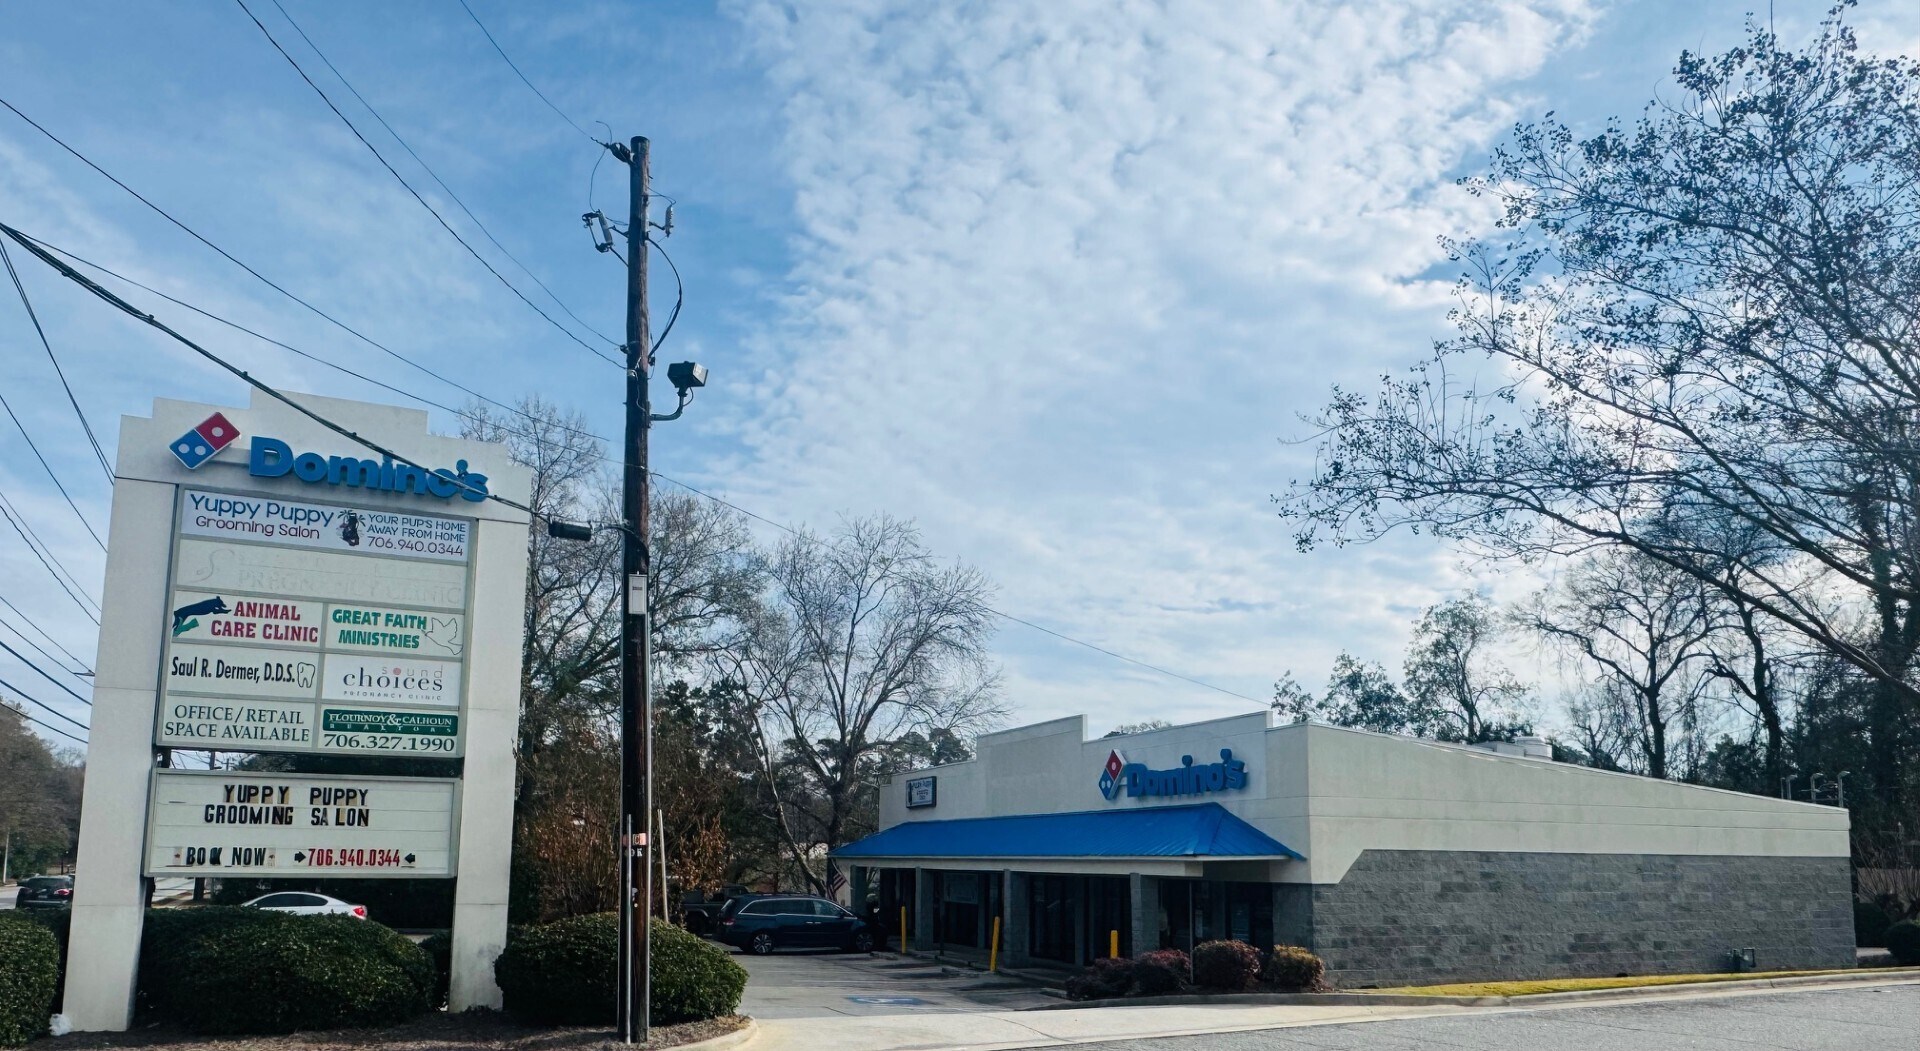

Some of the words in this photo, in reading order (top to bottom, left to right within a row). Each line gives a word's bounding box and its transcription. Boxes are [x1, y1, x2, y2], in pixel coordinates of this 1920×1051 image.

[249, 435, 490, 503] Domino's
[190, 493, 261, 518] Yuppy
[267, 501, 334, 527] Puppy
[196, 515, 275, 536] Grooming
[278, 523, 320, 539] Salon
[366, 524, 398, 536] AWAY
[402, 527, 432, 540] FROM
[435, 531, 465, 543] HOME
[368, 514, 399, 526] YOUR
[402, 517, 433, 529] PUP'S
[435, 519, 466, 533] HOME
[367, 536, 463, 556] 706.940.0344
[233, 601, 300, 621] ANIMAL
[332, 609, 381, 627] GREAT
[384, 613, 427, 630] FAITH
[211, 620, 256, 638] CARE
[262, 624, 319, 643] CLINIC
[338, 630, 420, 649] MINISTRIES
[172, 656, 197, 677] Saul
[201, 658, 212, 678] R.
[216, 659, 260, 684] Dermer,
[263, 662, 295, 683] D.D.S.
[343, 667, 443, 691] choices
[165, 722, 217, 738] SPACE
[222, 725, 310, 742] AVAILABLE
[323, 734, 455, 752] 706.327.1990
[1127, 748, 1248, 797] Domino's
[224, 785, 289, 804] YUPPY
[309, 787, 369, 805] PUPPY
[204, 804, 294, 825] GROOMING
[232, 847, 267, 865] NOW
[308, 849, 400, 867] 706.940.0344
